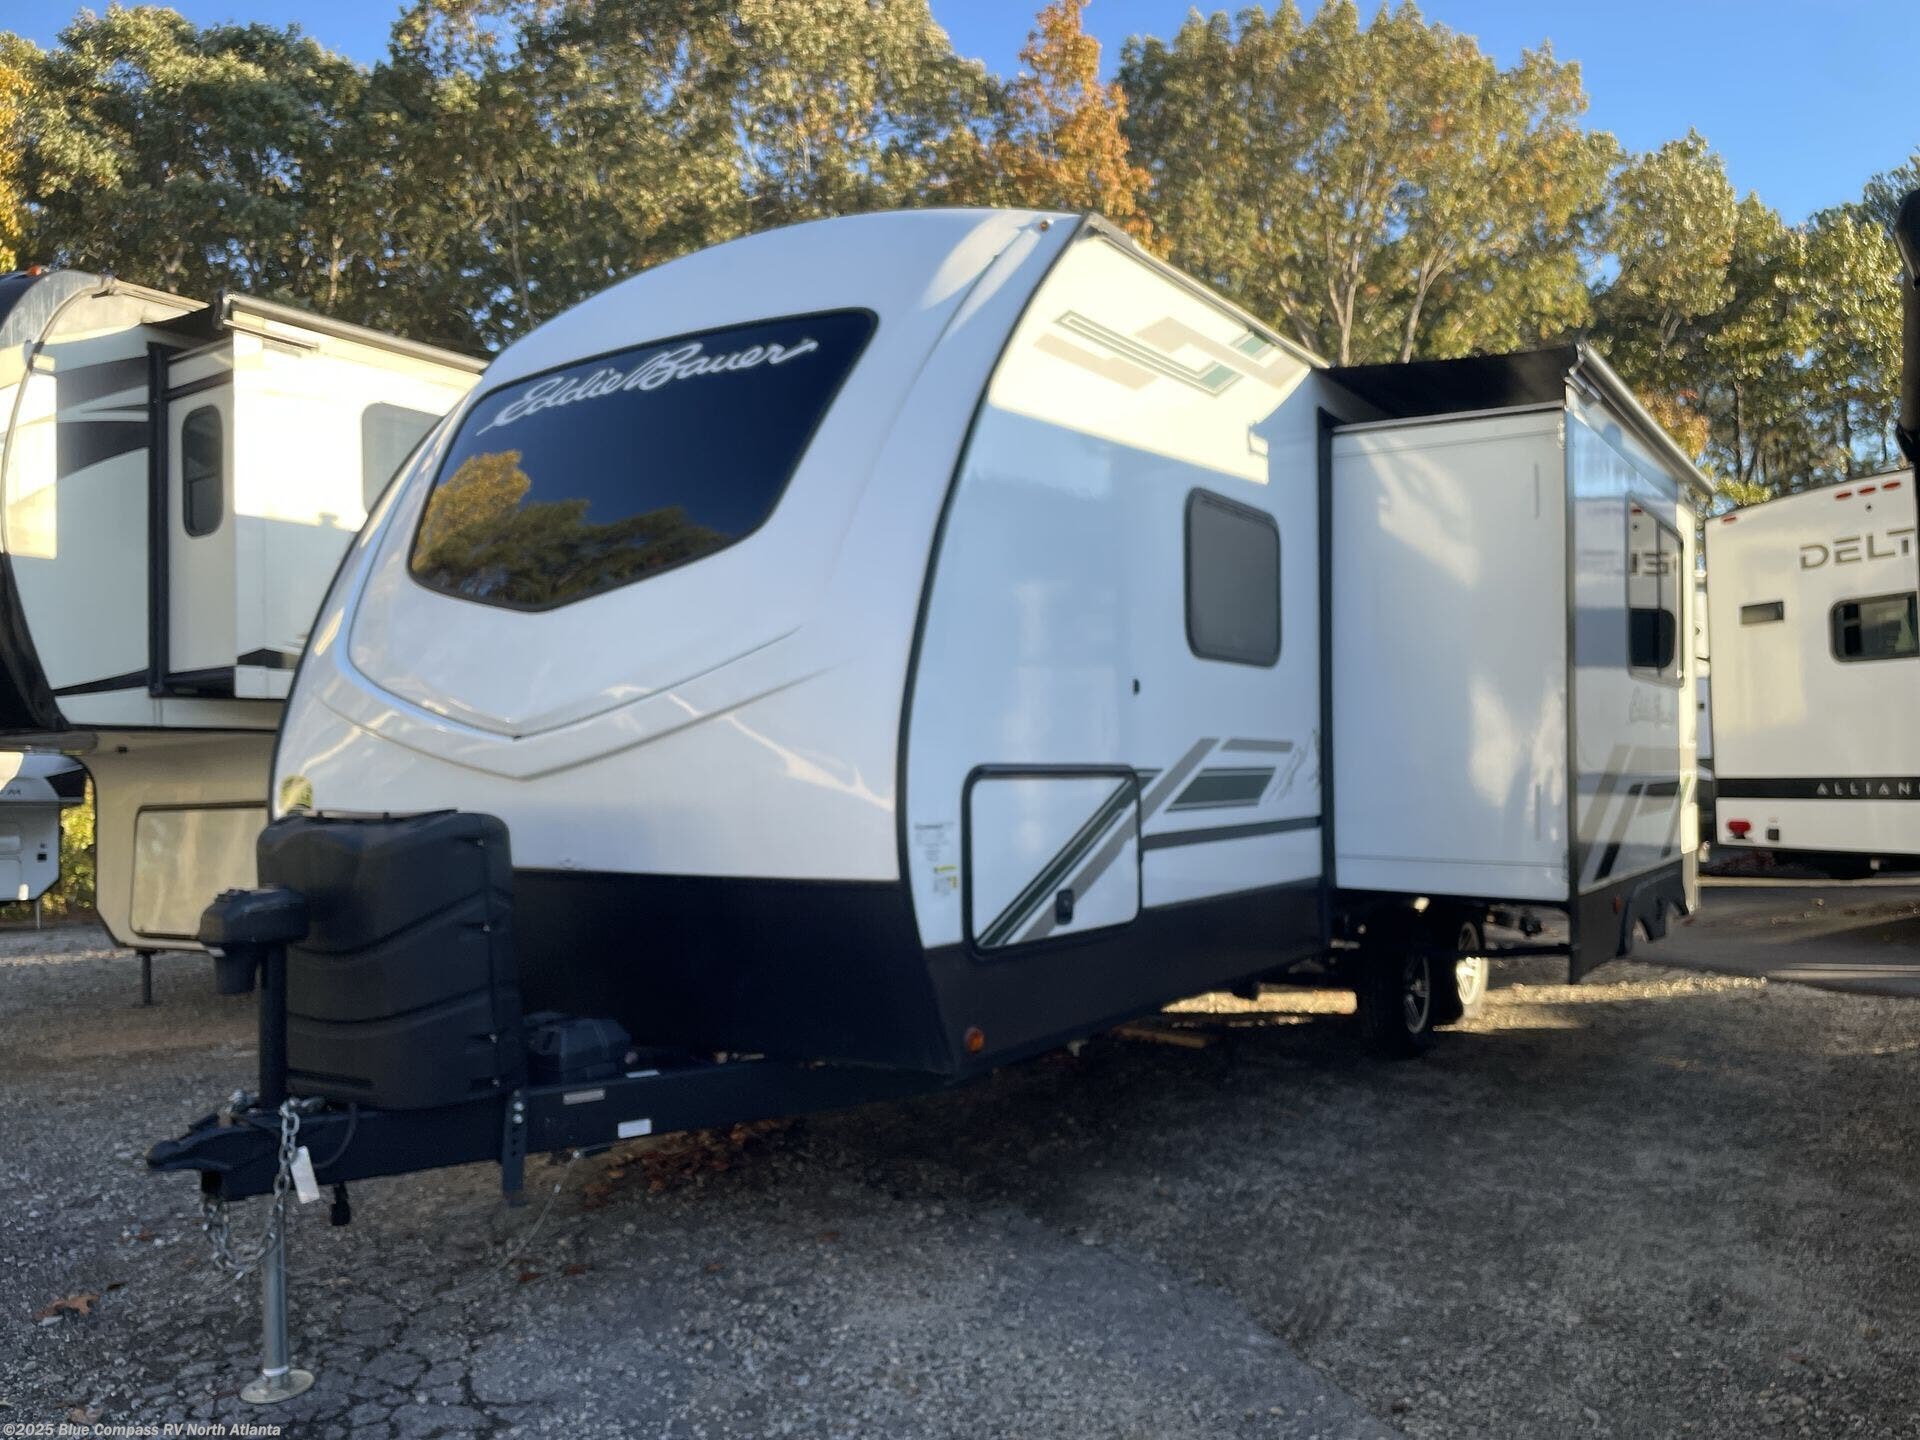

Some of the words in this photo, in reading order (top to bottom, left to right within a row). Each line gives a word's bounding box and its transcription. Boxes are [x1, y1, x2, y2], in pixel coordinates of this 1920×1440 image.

[476, 367, 623, 436] Eddie
[623, 339, 819, 391] Bauer
[1800, 528, 1915, 569] DELT
[1816, 782, 1920, 796] ALLIAN
